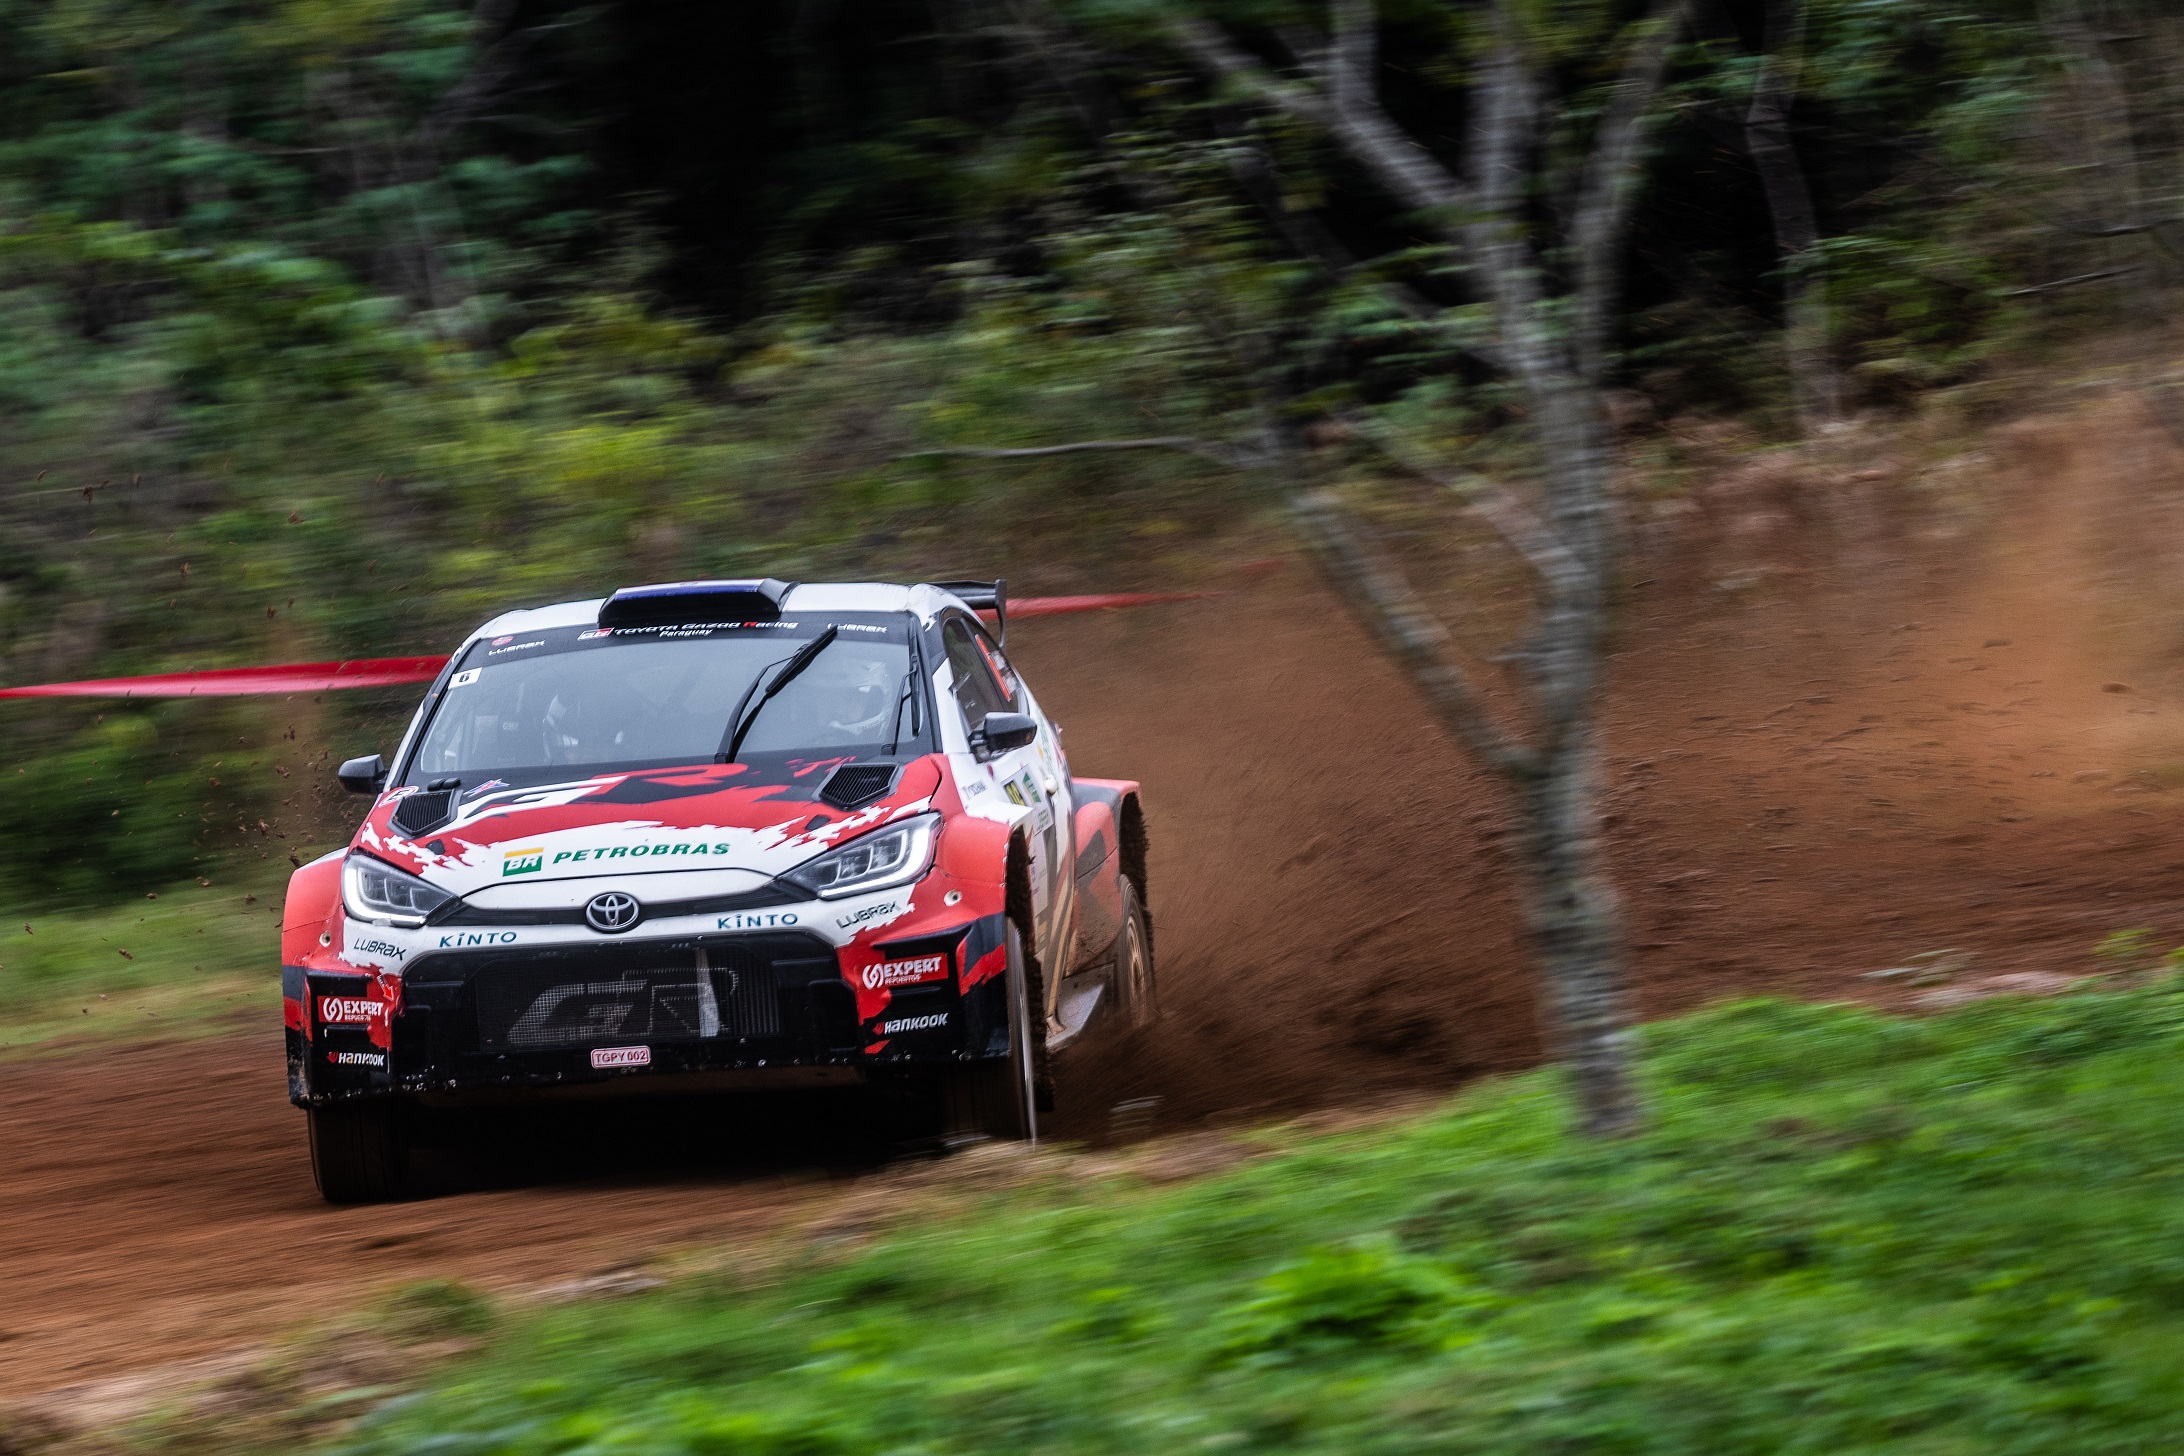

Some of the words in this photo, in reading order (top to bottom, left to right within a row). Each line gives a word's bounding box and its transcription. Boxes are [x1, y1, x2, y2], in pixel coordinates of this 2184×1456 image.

[659, 628, 714, 638] Paraguay
[458, 672, 471, 683] 6
[505, 856, 541, 869] BR
[552, 843, 731, 864] PETROBRAS
[884, 956, 943, 977] EXPERT
[343, 1000, 384, 1017] EXPERT
[595, 1053, 626, 1063] TGPY
[627, 1050, 648, 1062] 002
